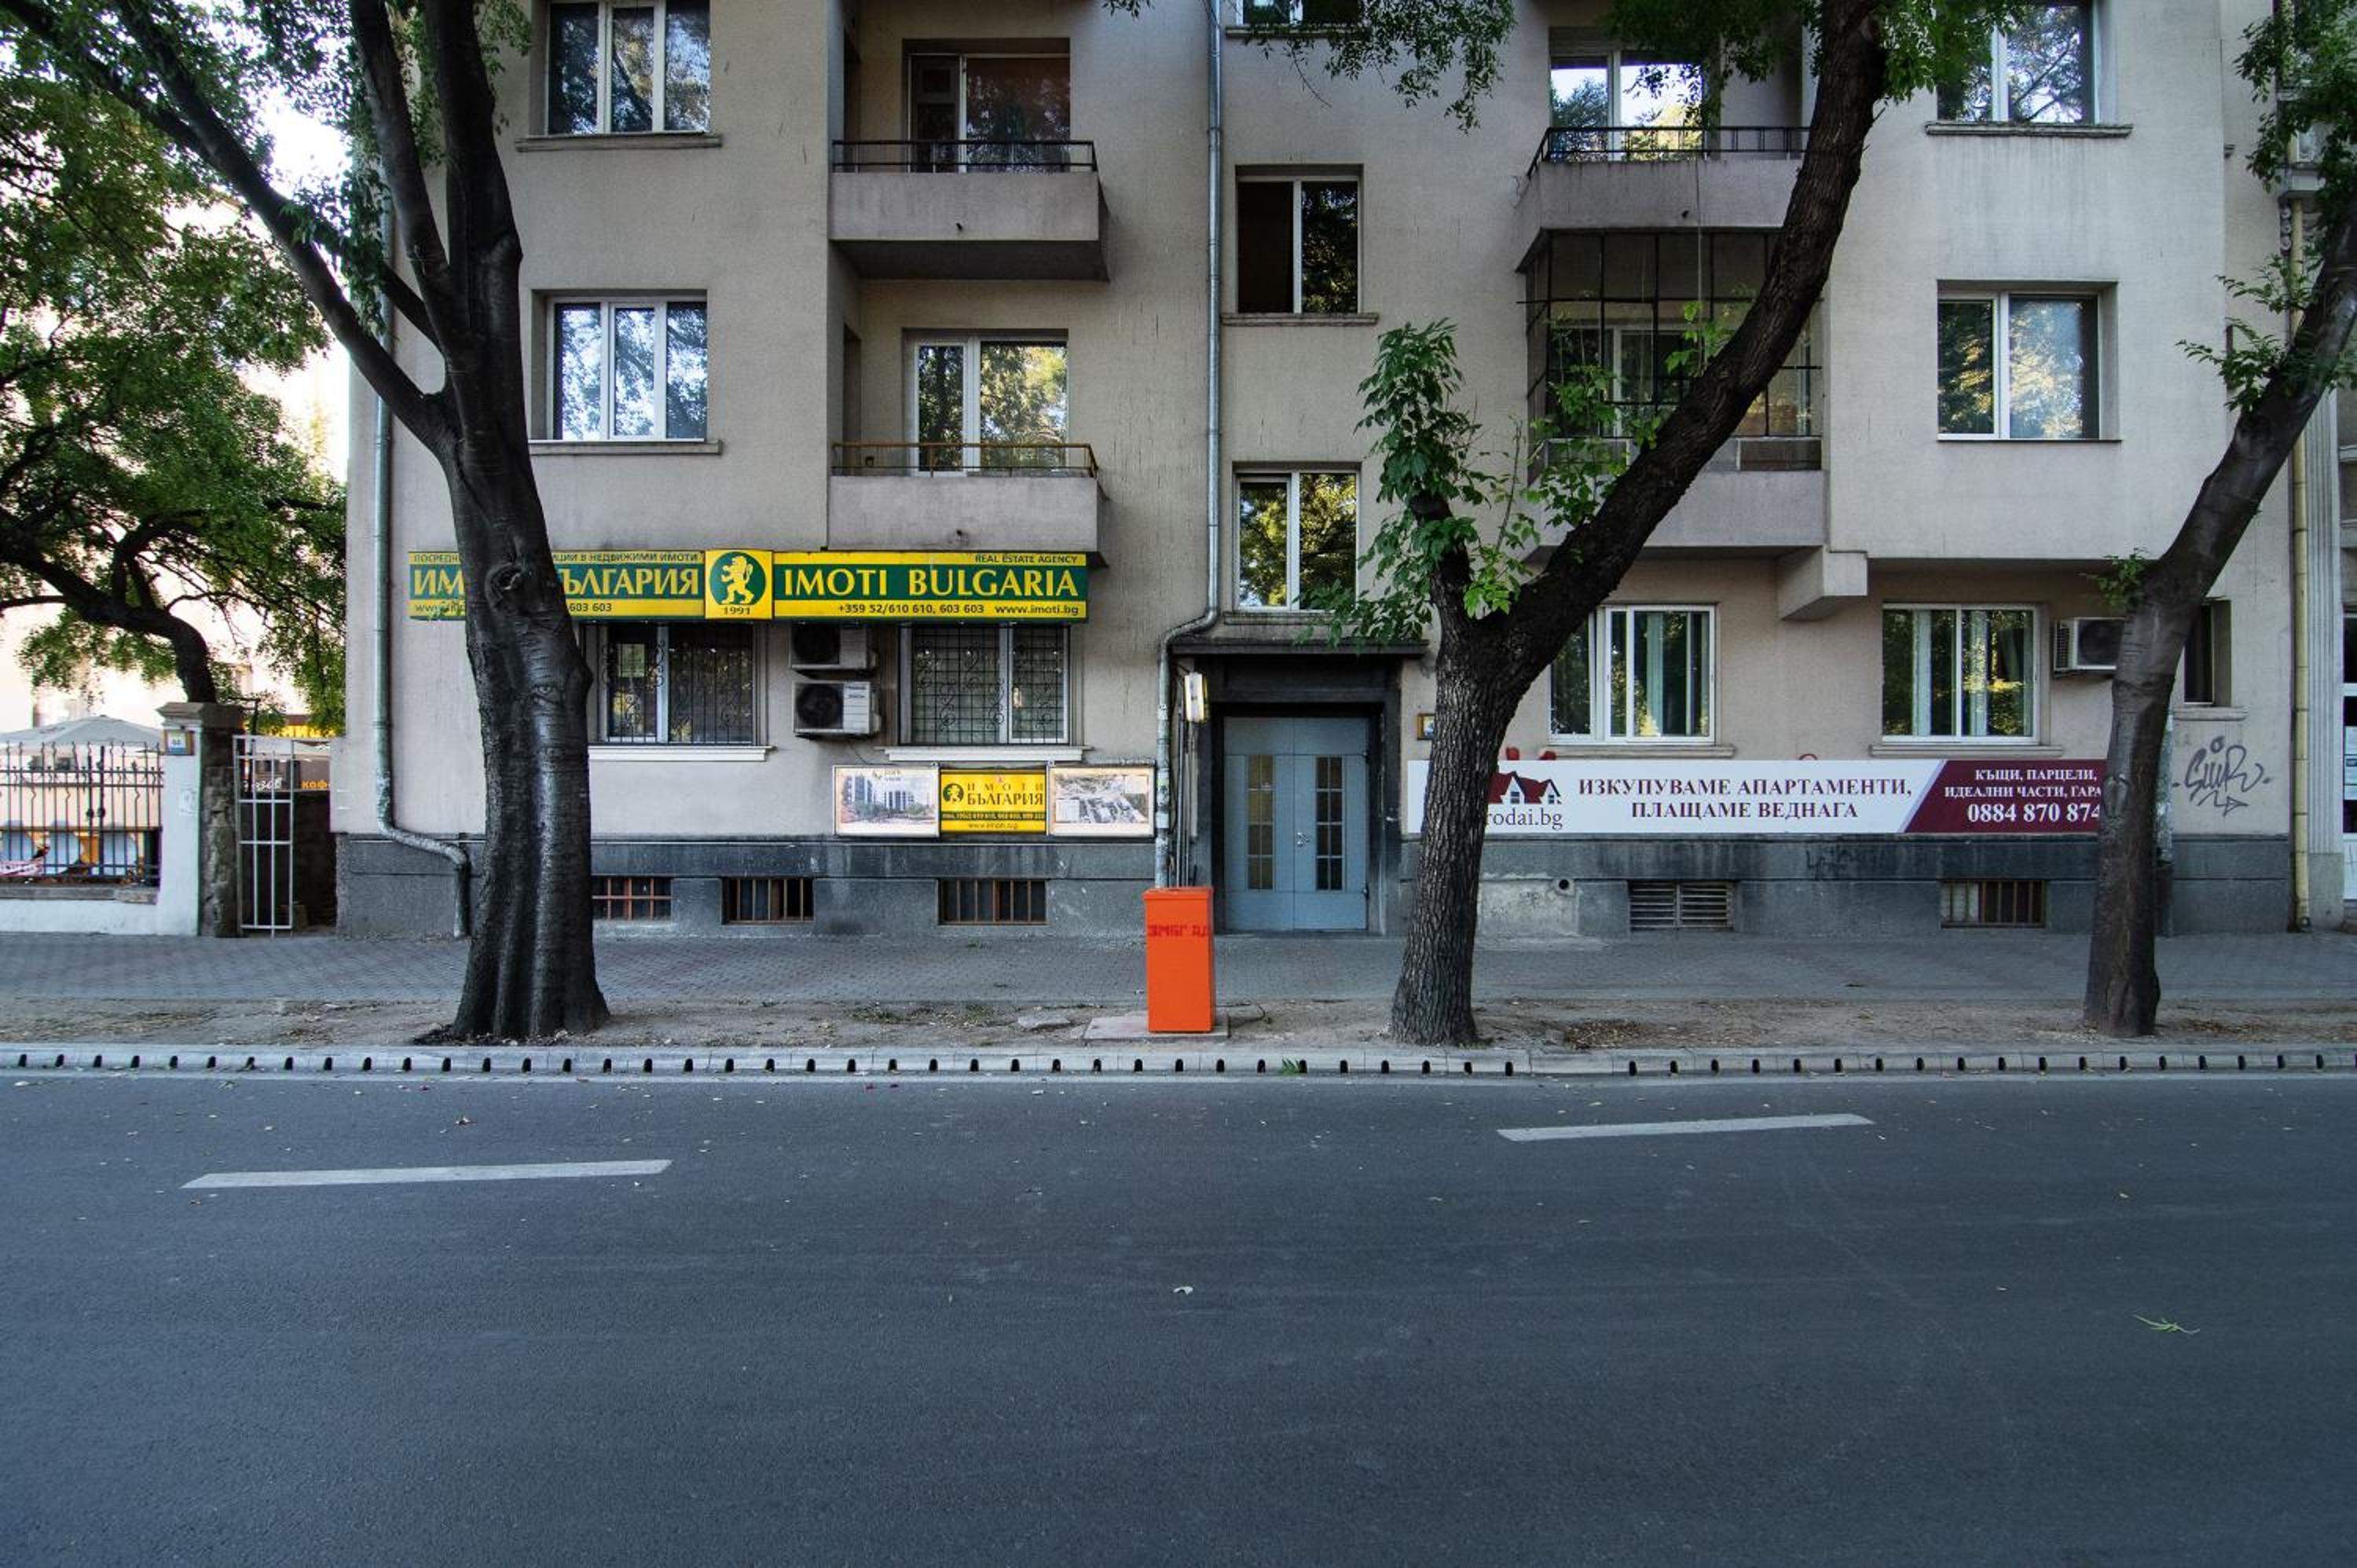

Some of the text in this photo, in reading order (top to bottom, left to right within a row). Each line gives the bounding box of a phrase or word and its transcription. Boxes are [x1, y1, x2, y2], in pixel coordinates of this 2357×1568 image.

[590, 553, 658, 562] НЕДВИЖИМИ
[975, 555, 999, 563] REAL
[1038, 555, 1078, 564] AGENCY
[558, 568, 698, 595] ЪЛГАРИЯ
[784, 569, 1079, 596] IMOTI BULGARIA
[569, 603, 613, 612] 603 603
[838, 604, 1079, 616] +359 52/610 610, 603 603 www.imoti.bg
[1974, 769, 2097, 782] КЪЩИ, ПАРЦЕЛИ,
[1578, 779, 1912, 797] ИЗКУПУВАМЕ АПАРТАМЕНТИ,
[1944, 786, 2102, 800] ИДЕАЛНИ ЧАСТИ, ГАРА
[967, 793, 1043, 805] БЪЛГАРИЯ
[1488, 807, 1563, 830] odai.bg
[1631, 802, 1859, 821] ПЛАЩАМЕ ВЕДНАГА
[1967, 803, 2017, 823] 0884
[2023, 803, 2061, 823] 870
